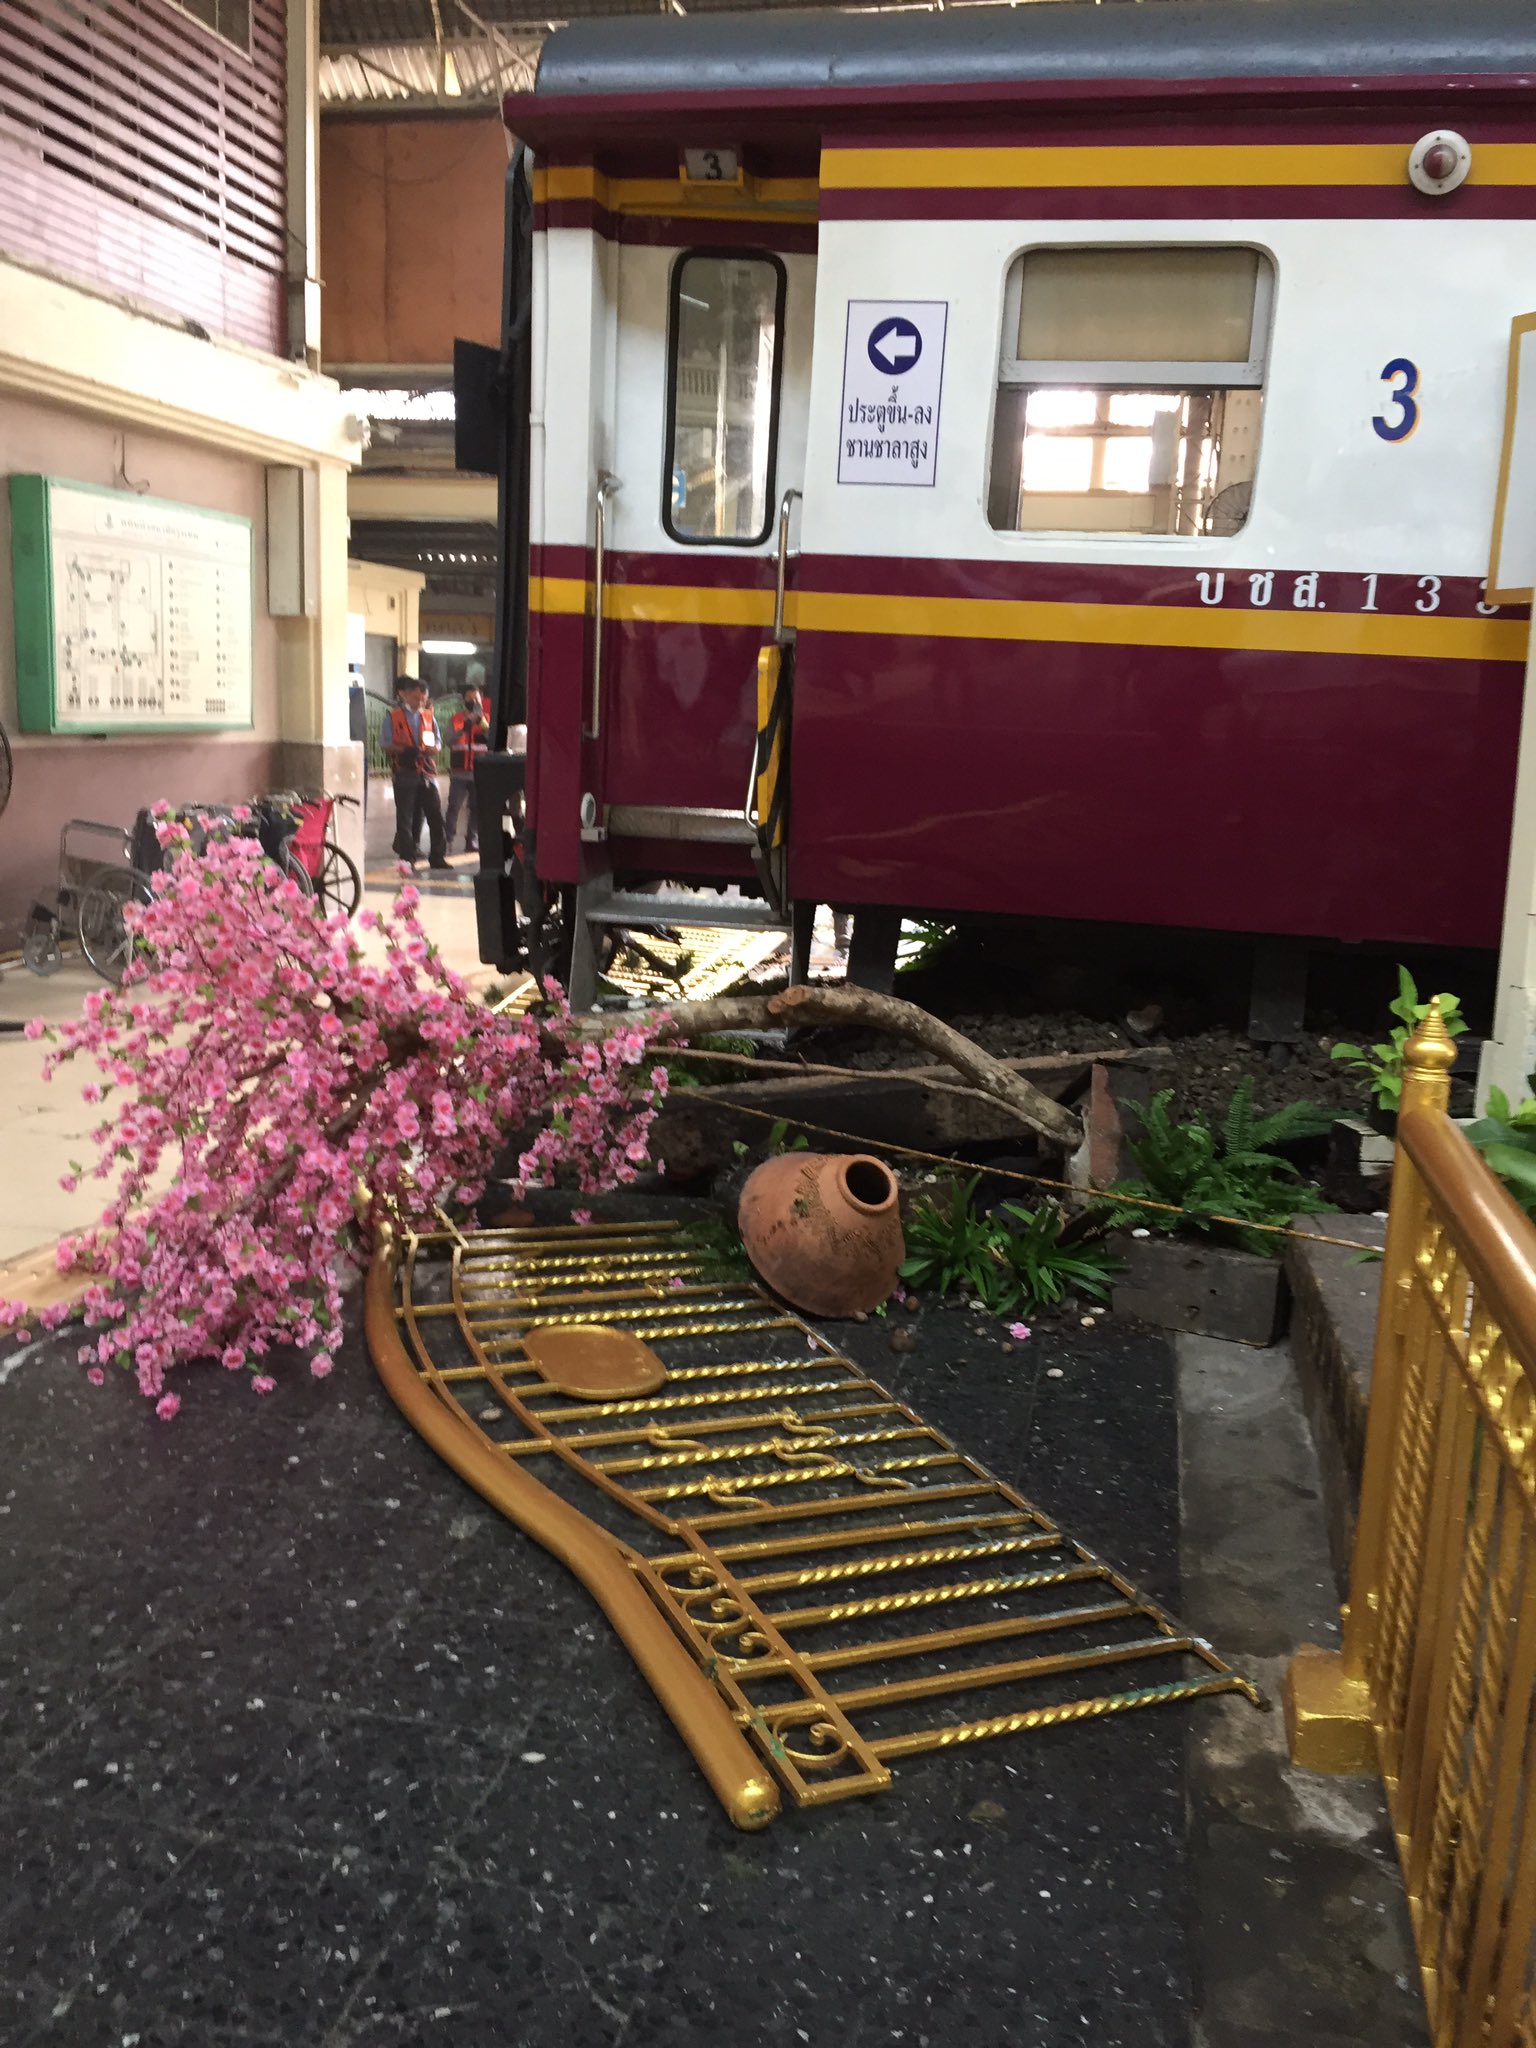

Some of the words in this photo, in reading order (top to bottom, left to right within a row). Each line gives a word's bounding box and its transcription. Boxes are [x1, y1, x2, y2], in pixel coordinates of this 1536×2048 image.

[703, 151, 722, 180] 3
[848, 385, 932, 433] ประตูขึ้น-ลง
[1372, 357, 1420, 443] 3
[846, 439, 928, 469] ชานชาลาสูง
